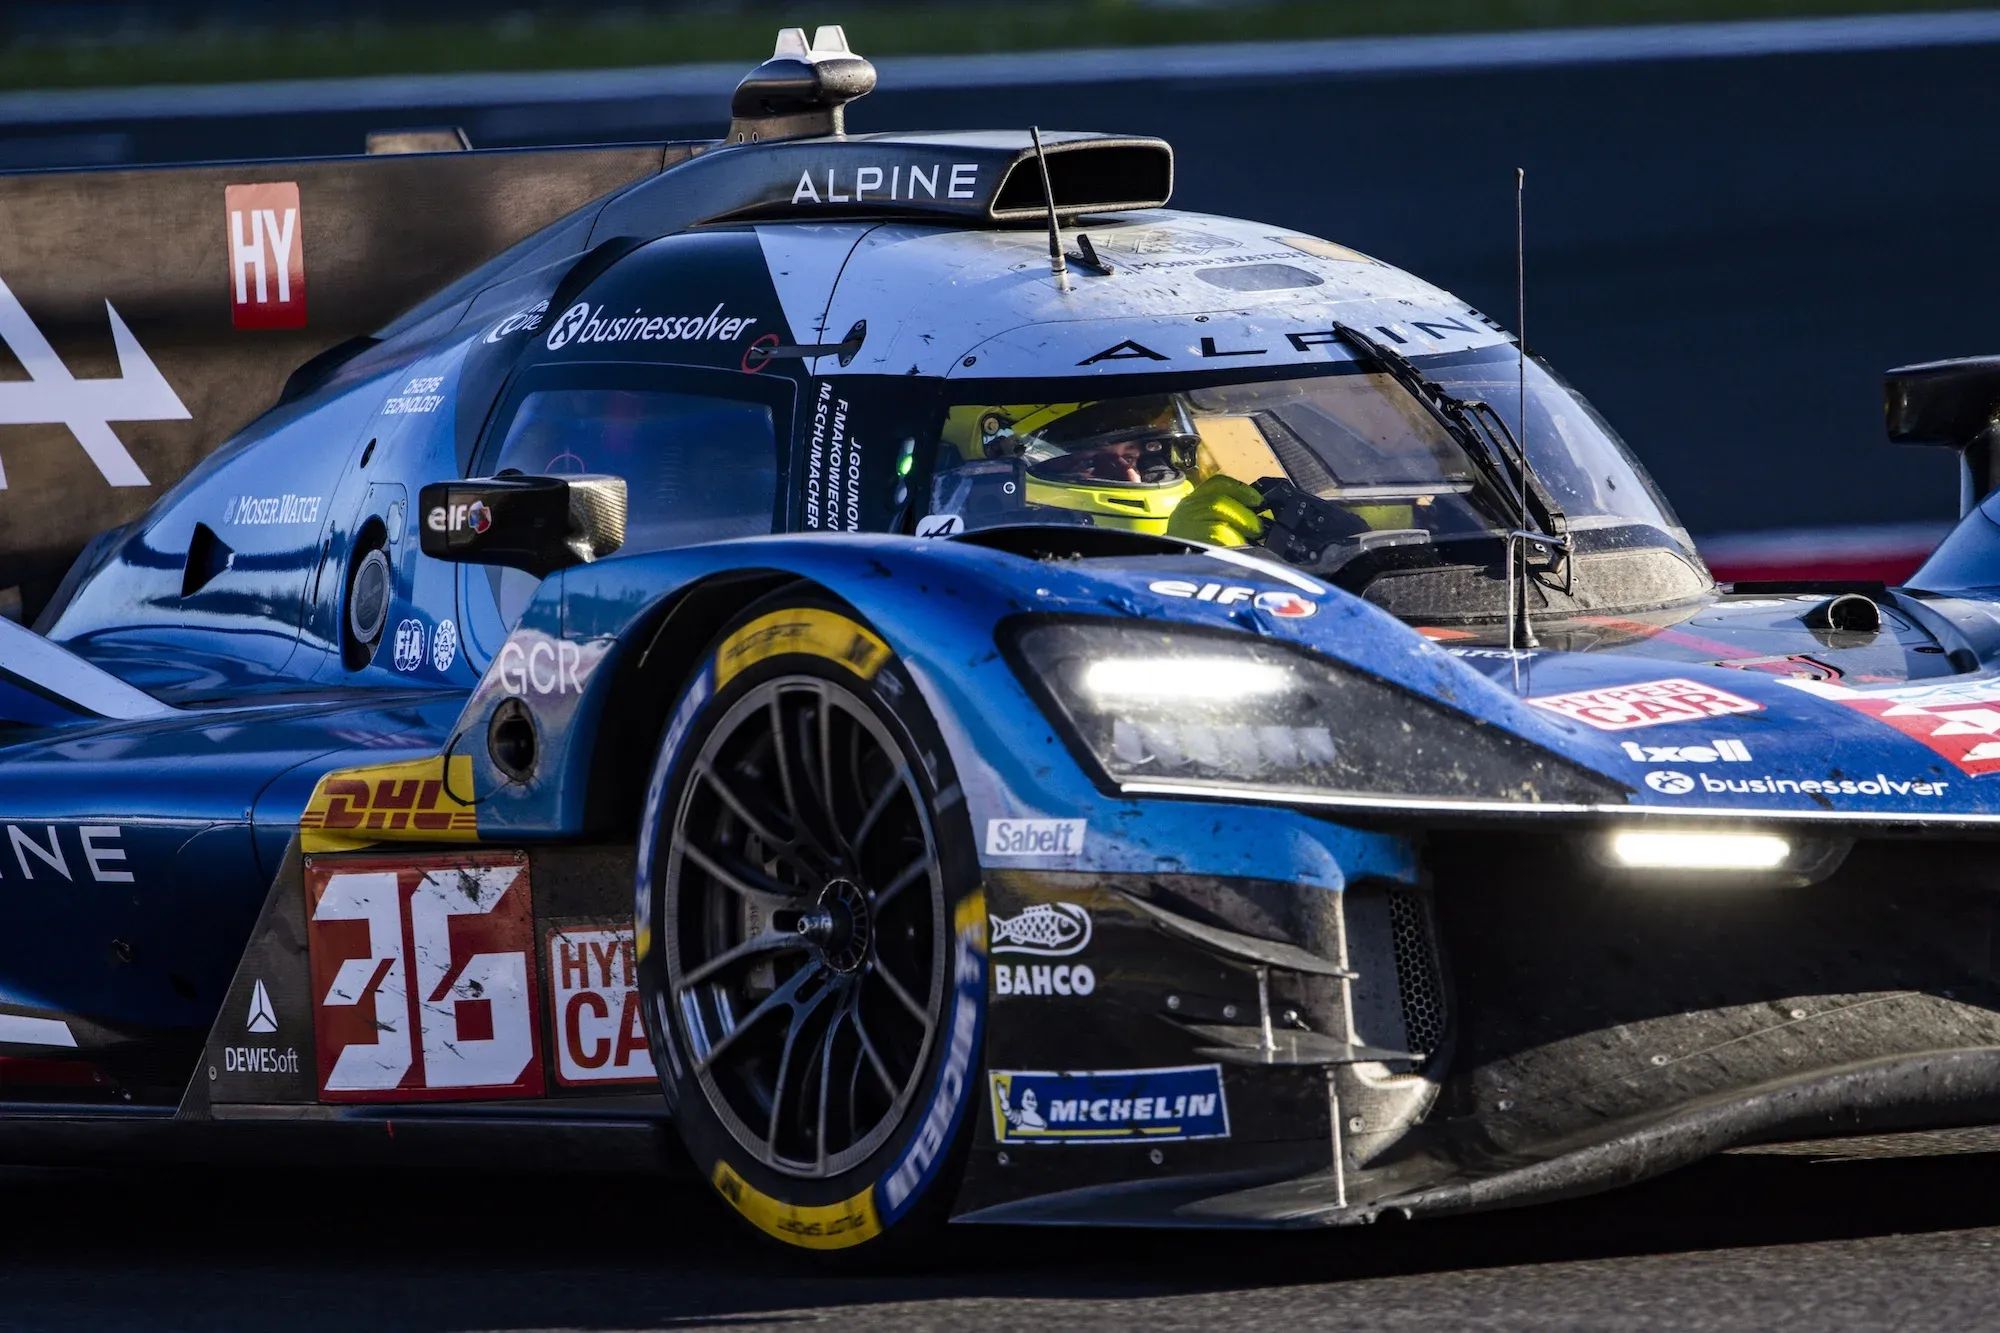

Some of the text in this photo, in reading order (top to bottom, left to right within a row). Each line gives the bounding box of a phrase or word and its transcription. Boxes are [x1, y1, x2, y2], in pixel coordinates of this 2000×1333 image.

[791, 164, 979, 205] ALPINE
[231, 208, 296, 304] HY
[577, 303, 757, 343] businessolver
[402, 376, 444, 395] CHEOPS
[381, 395, 445, 415] TECHNOLOGY
[807, 382, 832, 529] M.SCHUMACHER
[827, 398, 849, 531] F.MAKOWIECKI
[846, 436, 862, 534] J.GOUNON
[428, 504, 468, 531] elf
[1149, 580, 1256, 604] elf
[500, 641, 584, 695] GCR
[1541, 681, 1702, 709] HYPER
[1576, 692, 1741, 725] CAR
[1620, 739, 1753, 762] ixell
[1700, 773, 1949, 797] businessolver
[323, 779, 453, 829] DHL
[995, 822, 1074, 852] Sabelt
[312, 866, 534, 1091] 36
[995, 964, 1095, 996] BAHCO
[225, 1047, 299, 1073] DEWESoft
[1050, 1094, 1217, 1122] MICHELIN
